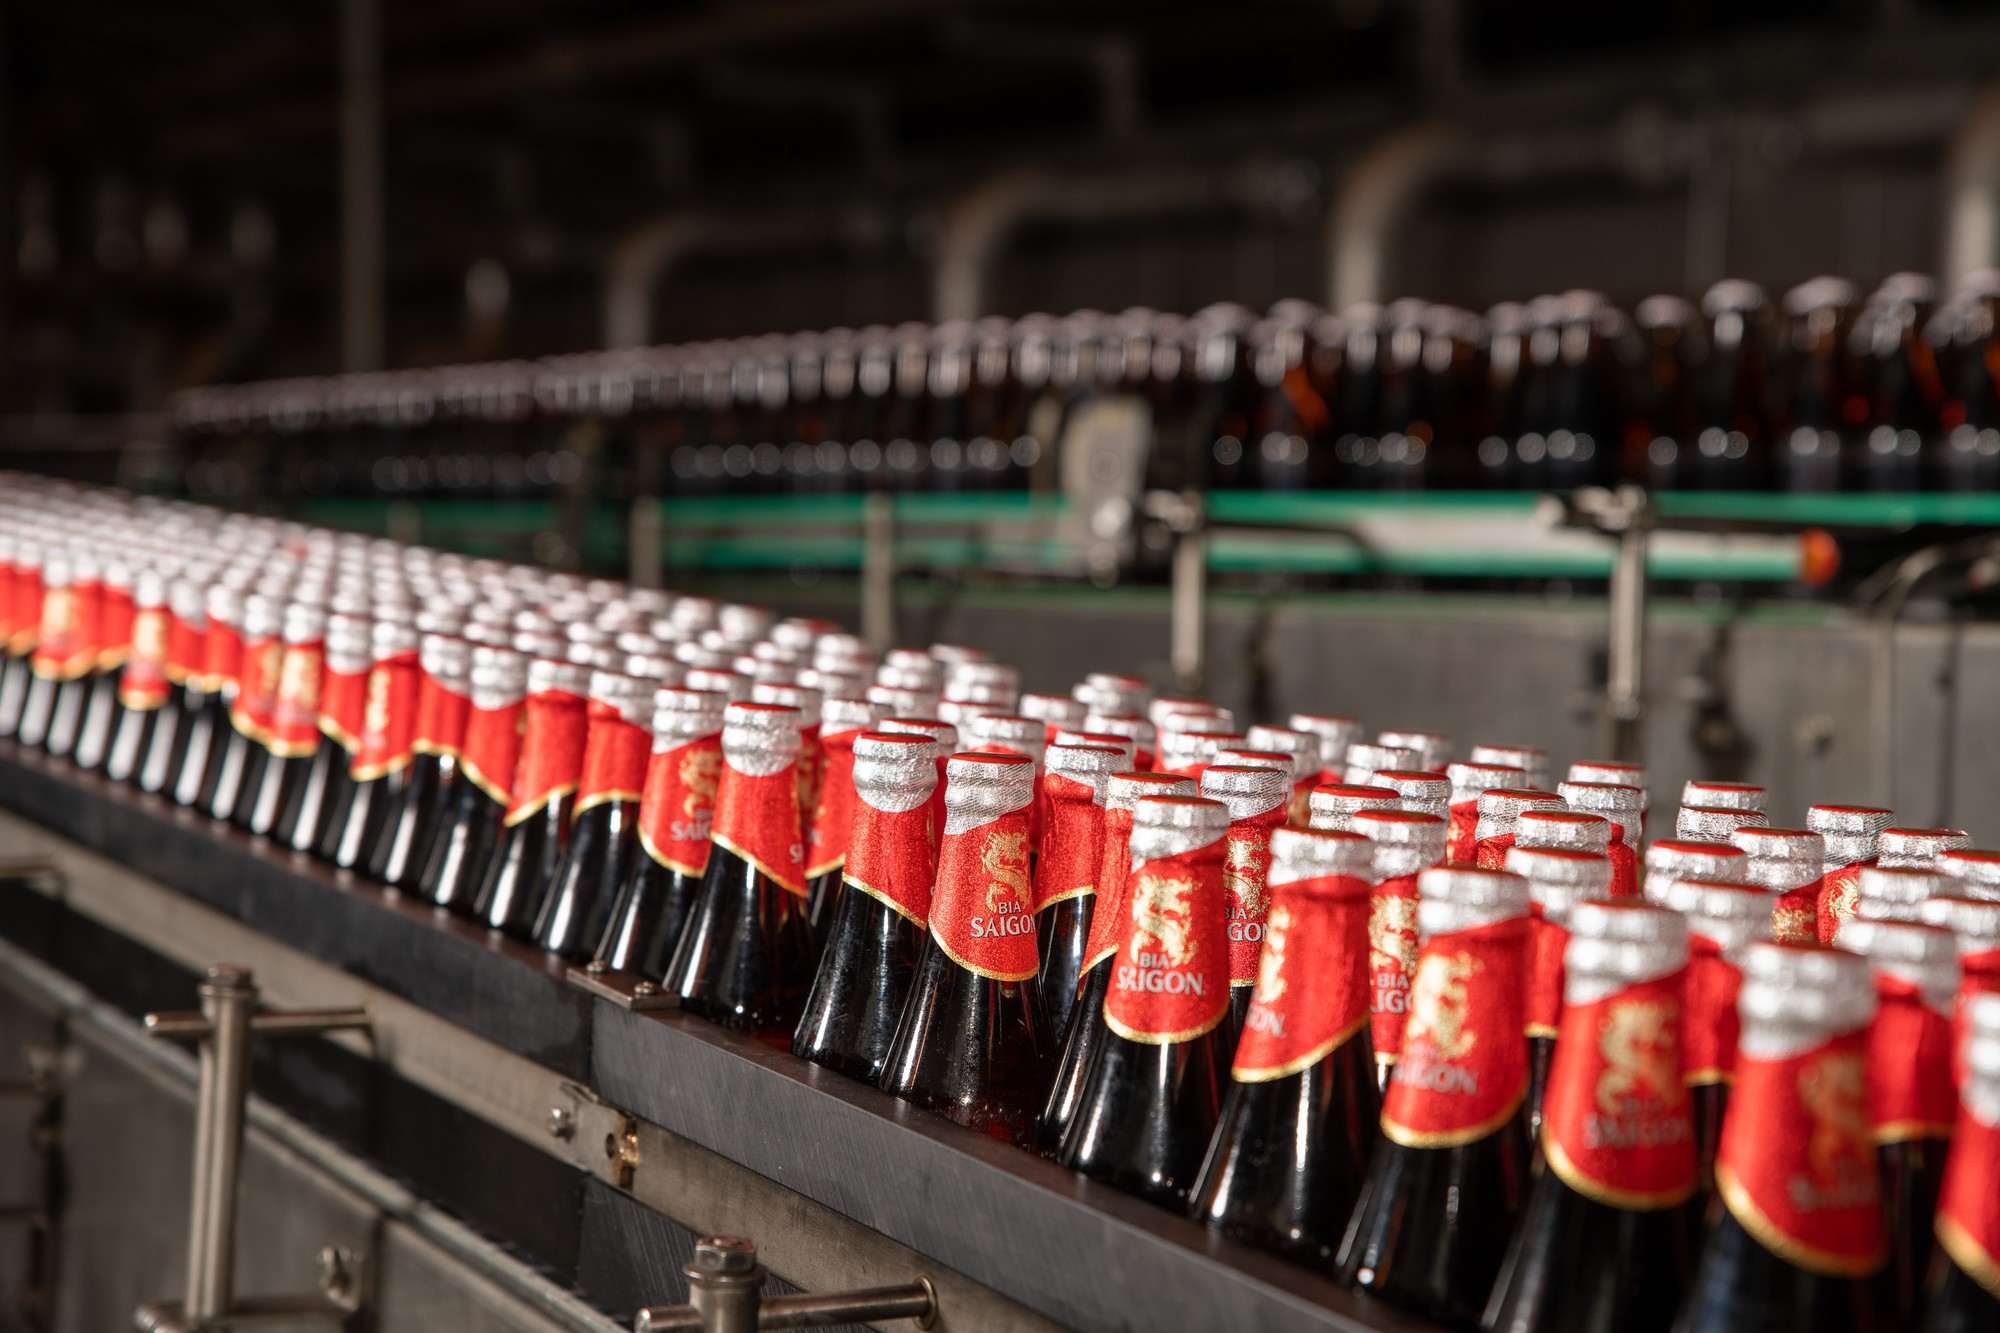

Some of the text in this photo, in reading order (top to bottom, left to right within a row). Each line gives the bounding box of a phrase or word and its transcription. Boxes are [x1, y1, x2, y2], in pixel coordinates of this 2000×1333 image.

[998, 900, 1022, 915] BIA
[970, 914, 1036, 938] SAIGON
[1139, 952, 1170, 969] BIA
[1115, 966, 1204, 996] SAIGON
[1377, 973, 1410, 990] BIA
